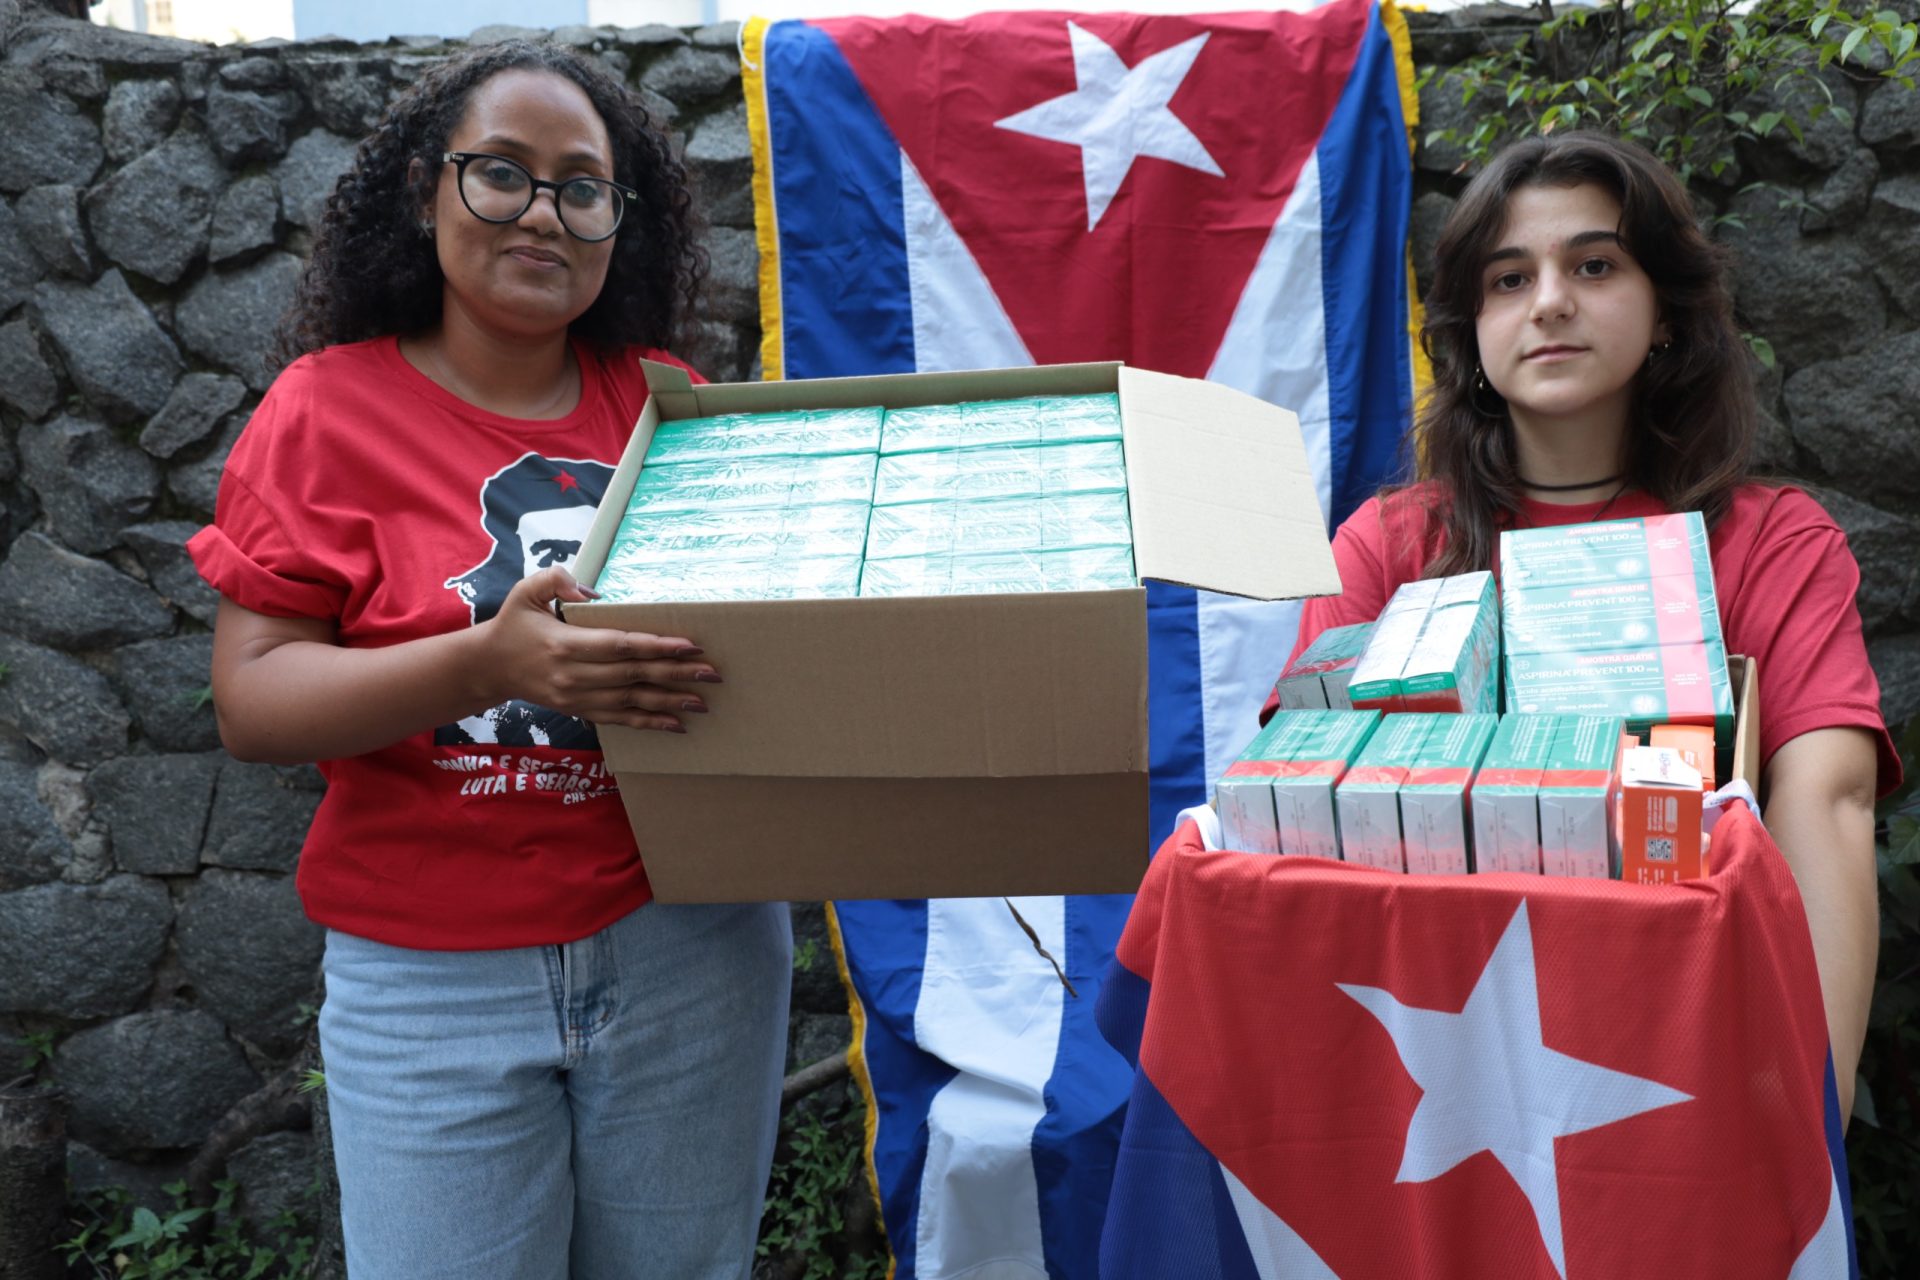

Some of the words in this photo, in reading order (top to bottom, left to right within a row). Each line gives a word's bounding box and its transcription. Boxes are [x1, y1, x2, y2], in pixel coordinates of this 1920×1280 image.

[1612, 532, 1629, 541] 100
[1518, 601, 1567, 611] SPIRINA
[1567, 597, 1617, 606] PREVENT
[1518, 670, 1570, 680] ASPIRINA
[1572, 667, 1623, 676] PREVENT
[1626, 665, 1645, 673] 100
[499, 754, 512, 769] E
[518, 756, 583, 774] SES
[460, 774, 507, 796] LUTA
[515, 773, 528, 791] E
[563, 792, 586, 805] CHE
